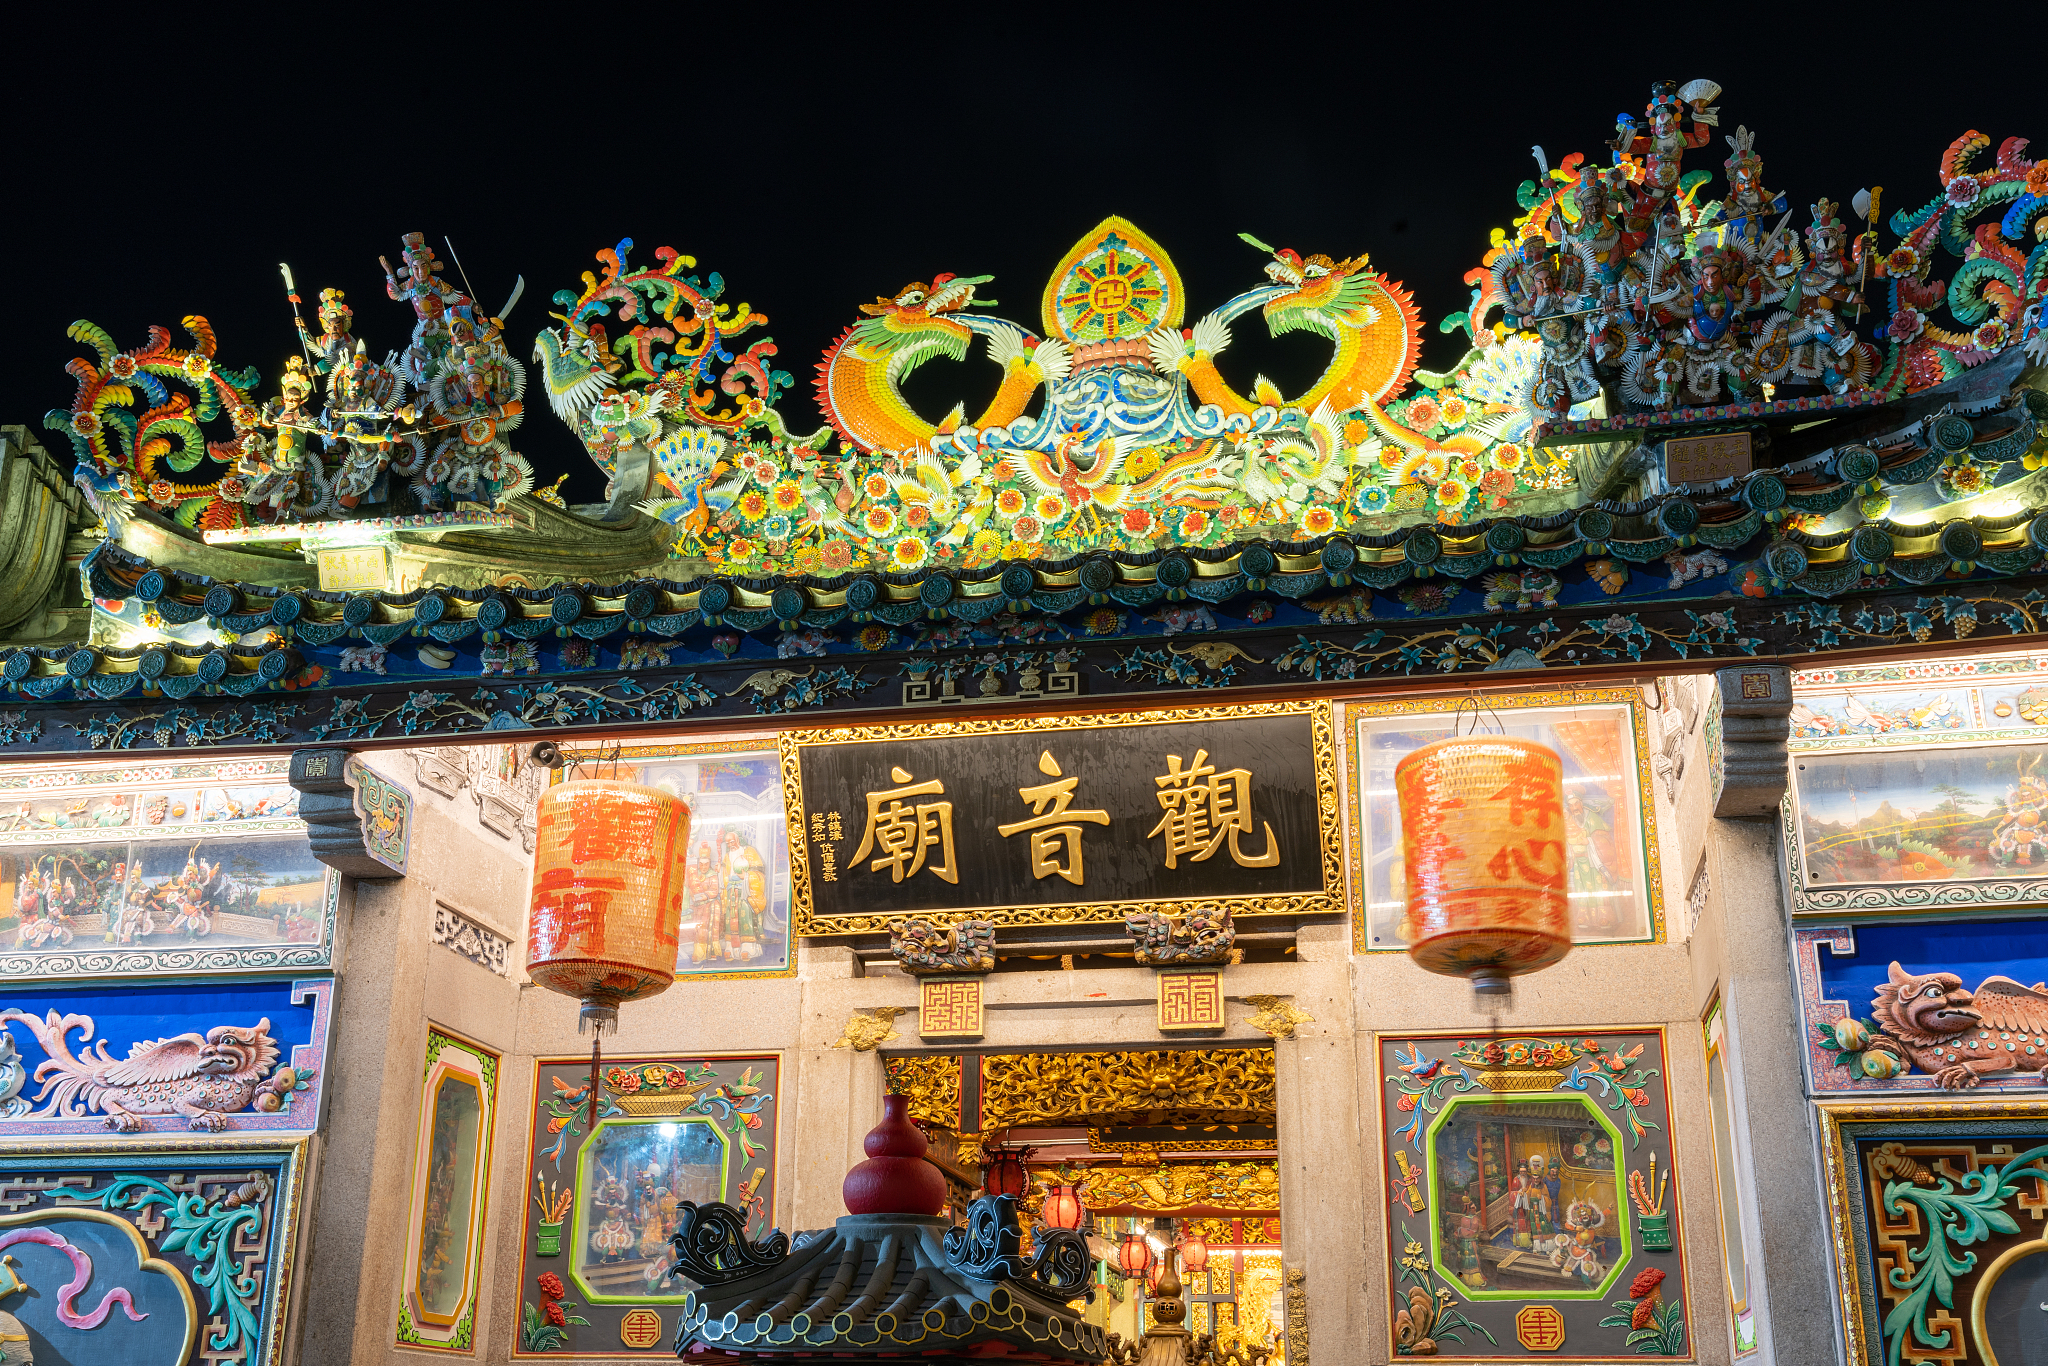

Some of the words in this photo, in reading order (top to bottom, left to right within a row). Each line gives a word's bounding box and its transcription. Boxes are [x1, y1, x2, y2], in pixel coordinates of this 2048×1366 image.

[324, 554, 379, 571] 狄青平西
[848, 748, 1281, 886] 觀音廟
